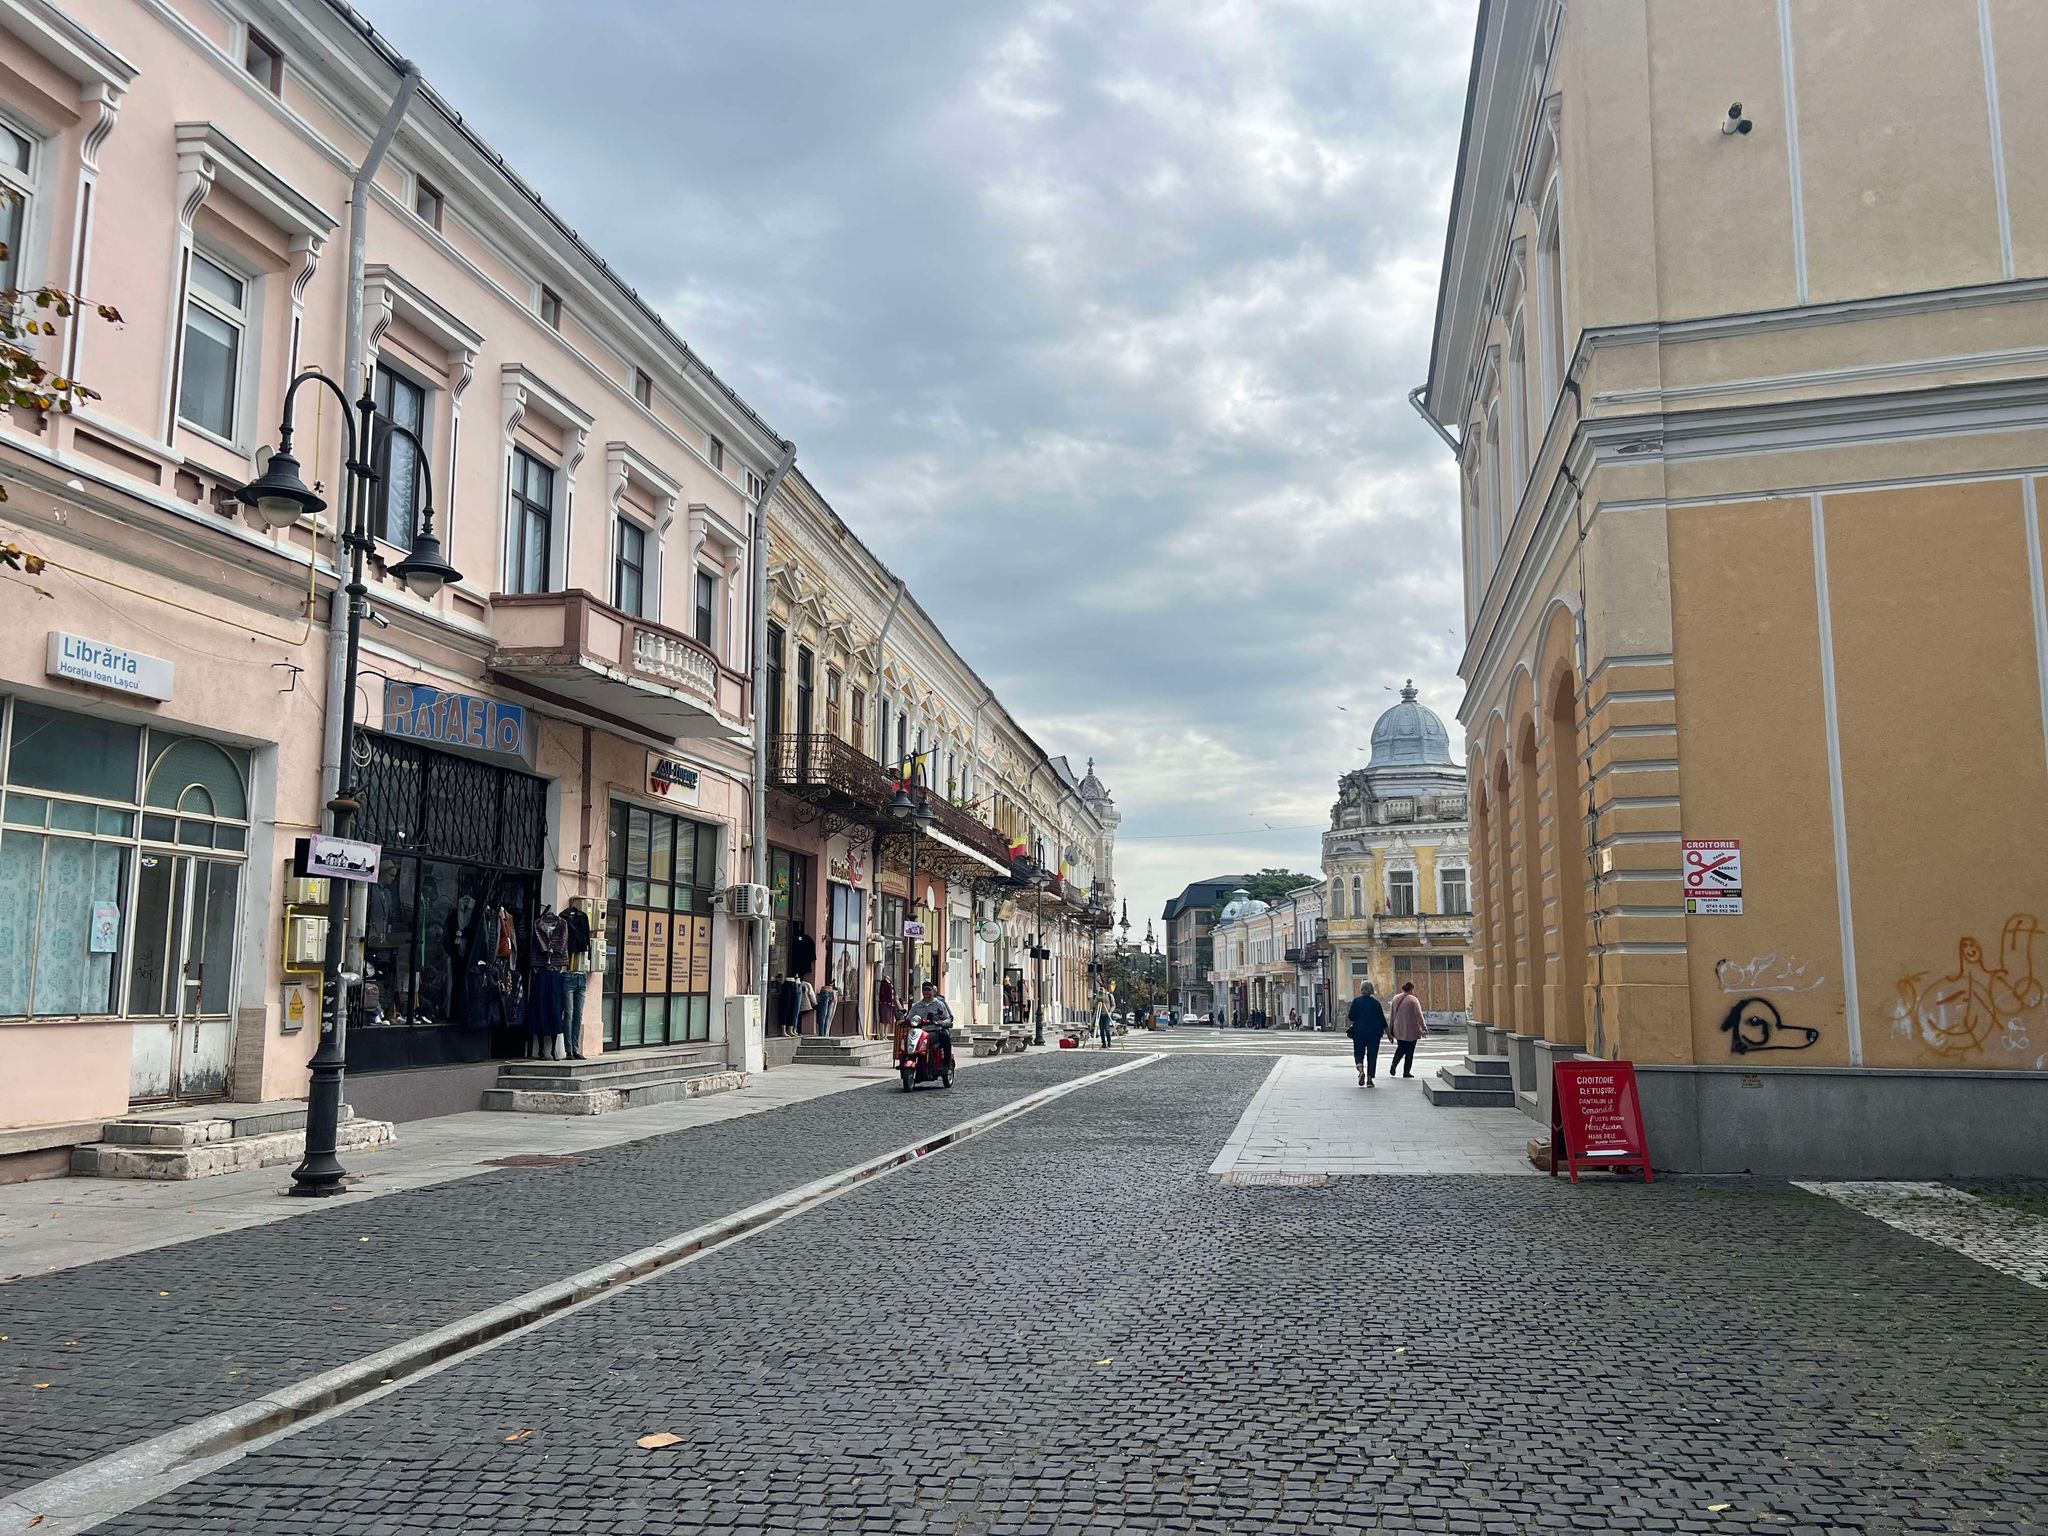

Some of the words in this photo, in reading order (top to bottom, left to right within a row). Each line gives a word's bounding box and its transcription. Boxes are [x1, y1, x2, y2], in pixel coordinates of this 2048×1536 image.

[64, 637, 136, 674] Librăria
[94, 670, 112, 683] Ioan
[1686, 841, 1735, 849] CROITORIE
